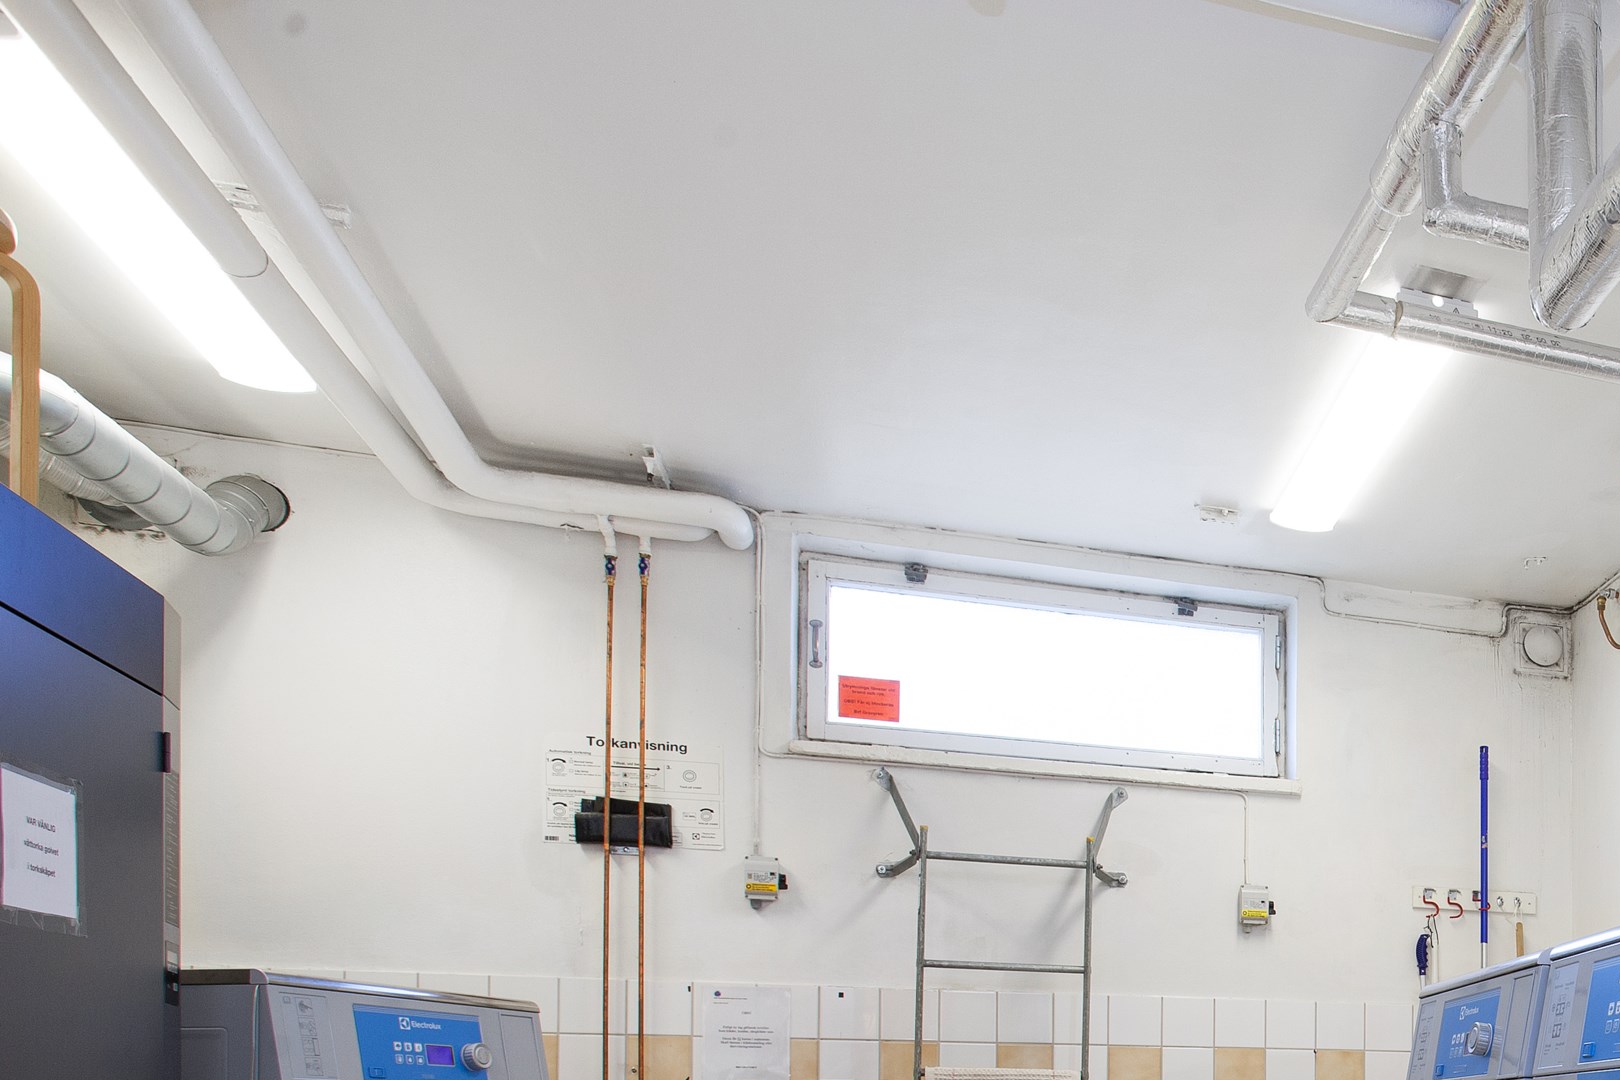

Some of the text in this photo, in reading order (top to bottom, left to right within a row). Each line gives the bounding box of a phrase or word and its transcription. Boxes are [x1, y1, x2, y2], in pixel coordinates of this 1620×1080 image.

[586, 736, 688, 754] Tokanisning
[26, 816, 56, 833] VAR VÄNLIG
[411, 1020, 441, 1030] Electrolux
